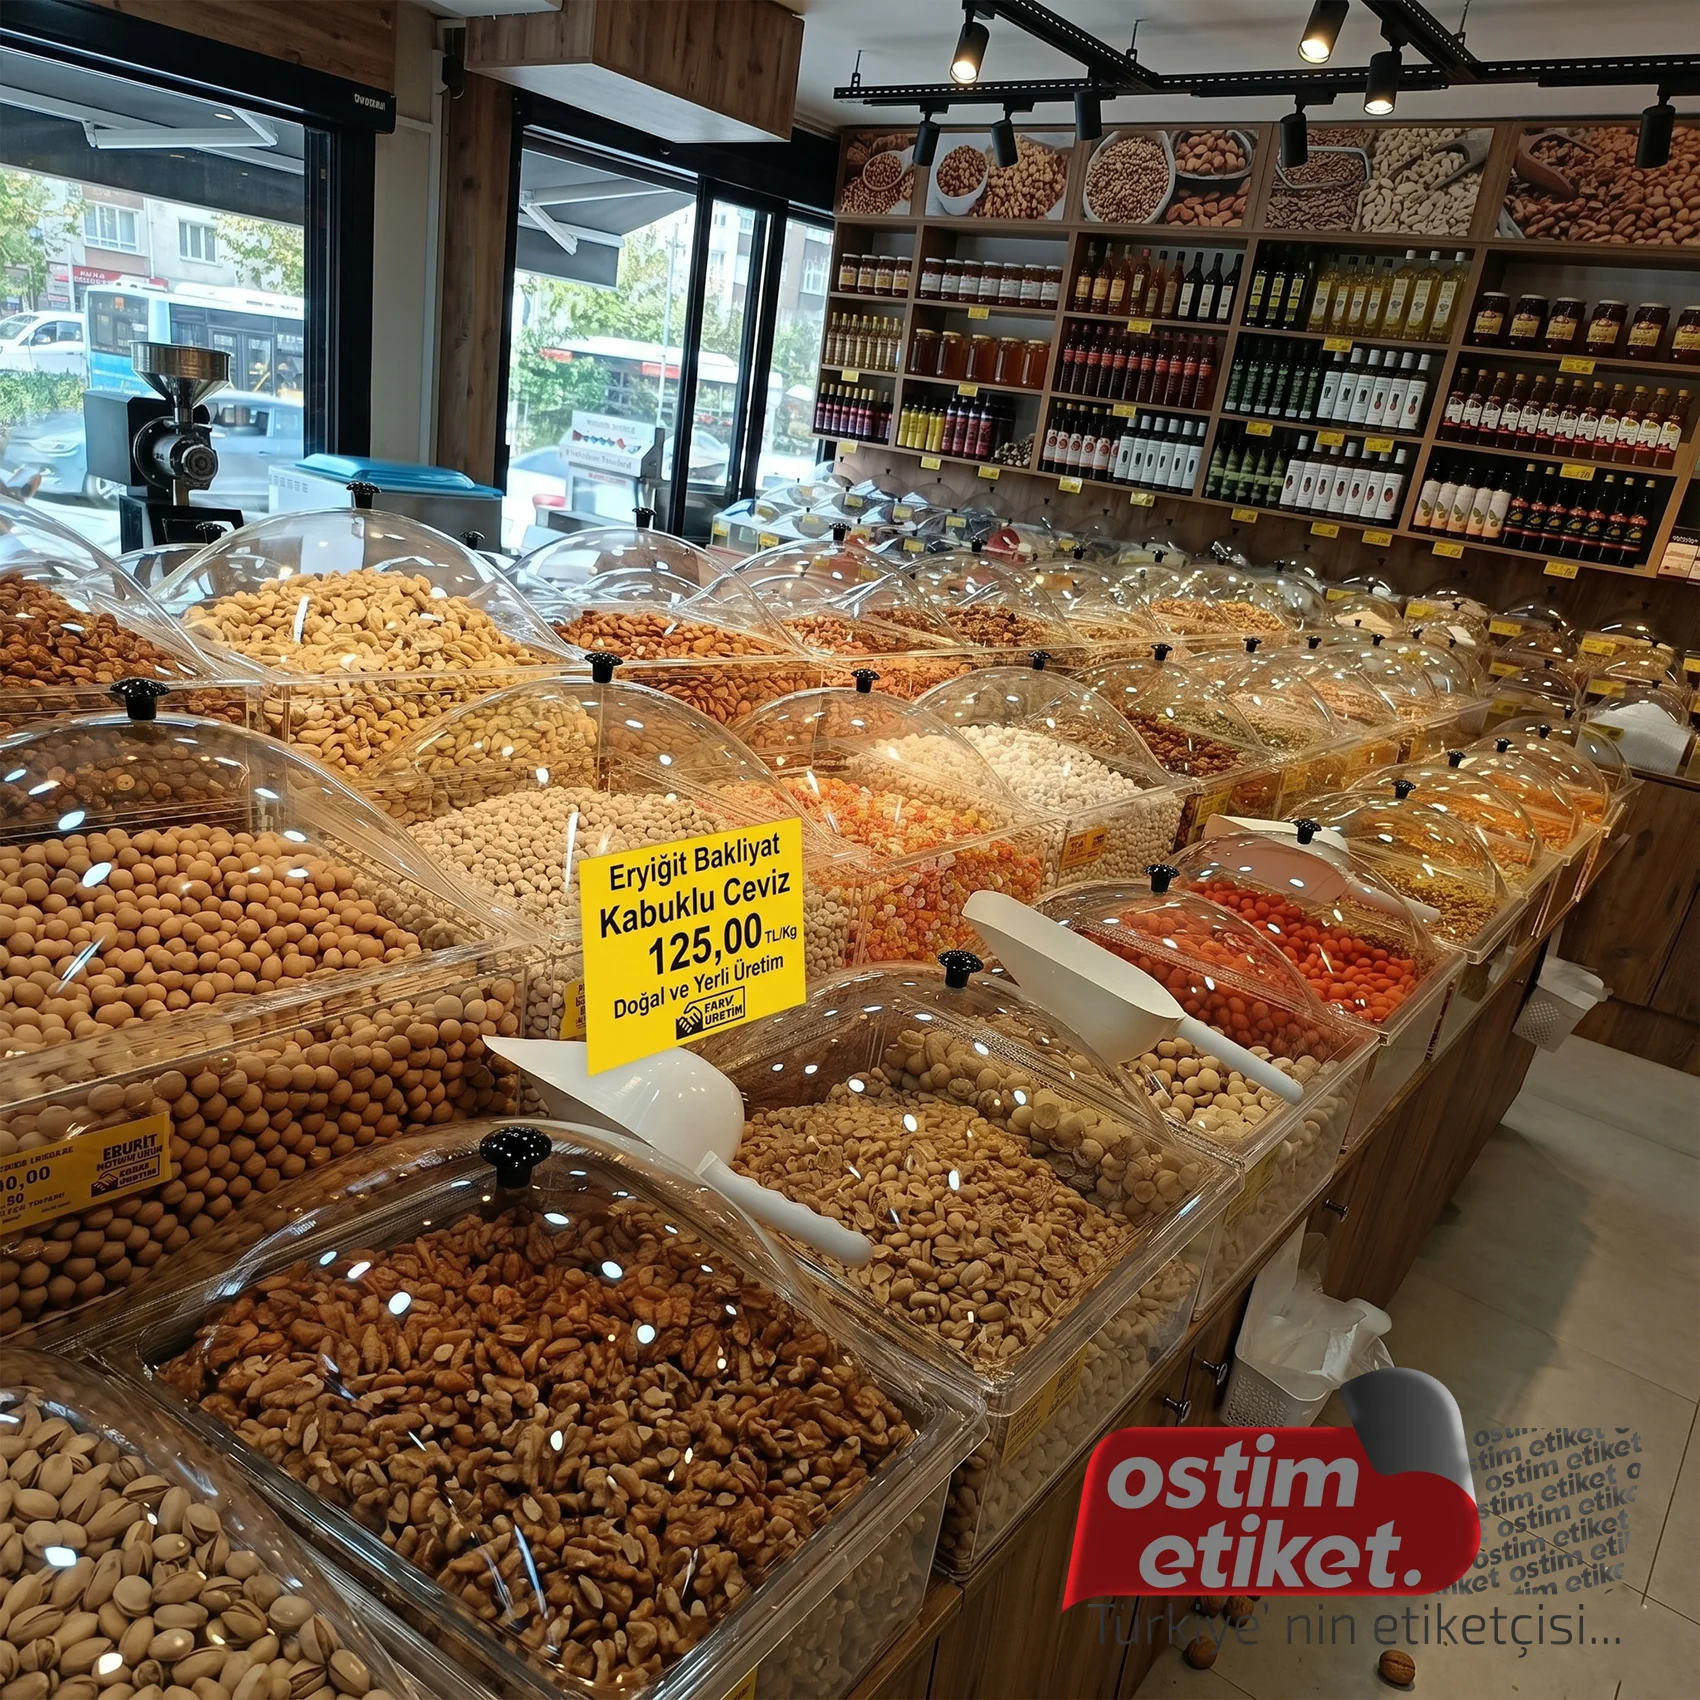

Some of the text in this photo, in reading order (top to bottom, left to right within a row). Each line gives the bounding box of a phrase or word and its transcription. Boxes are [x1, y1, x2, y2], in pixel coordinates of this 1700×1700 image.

[609, 832, 781, 892] Eryiğit Bakliyat
[599, 868, 791, 938] Kabuklu Ceviz
[648, 912, 797, 976] 125,00 TL/Kg
[614, 986, 665, 1020] Doğal
[669, 982, 690, 1000] ve
[694, 969, 730, 993] Yerli
[734, 954, 784, 982] Üretim
